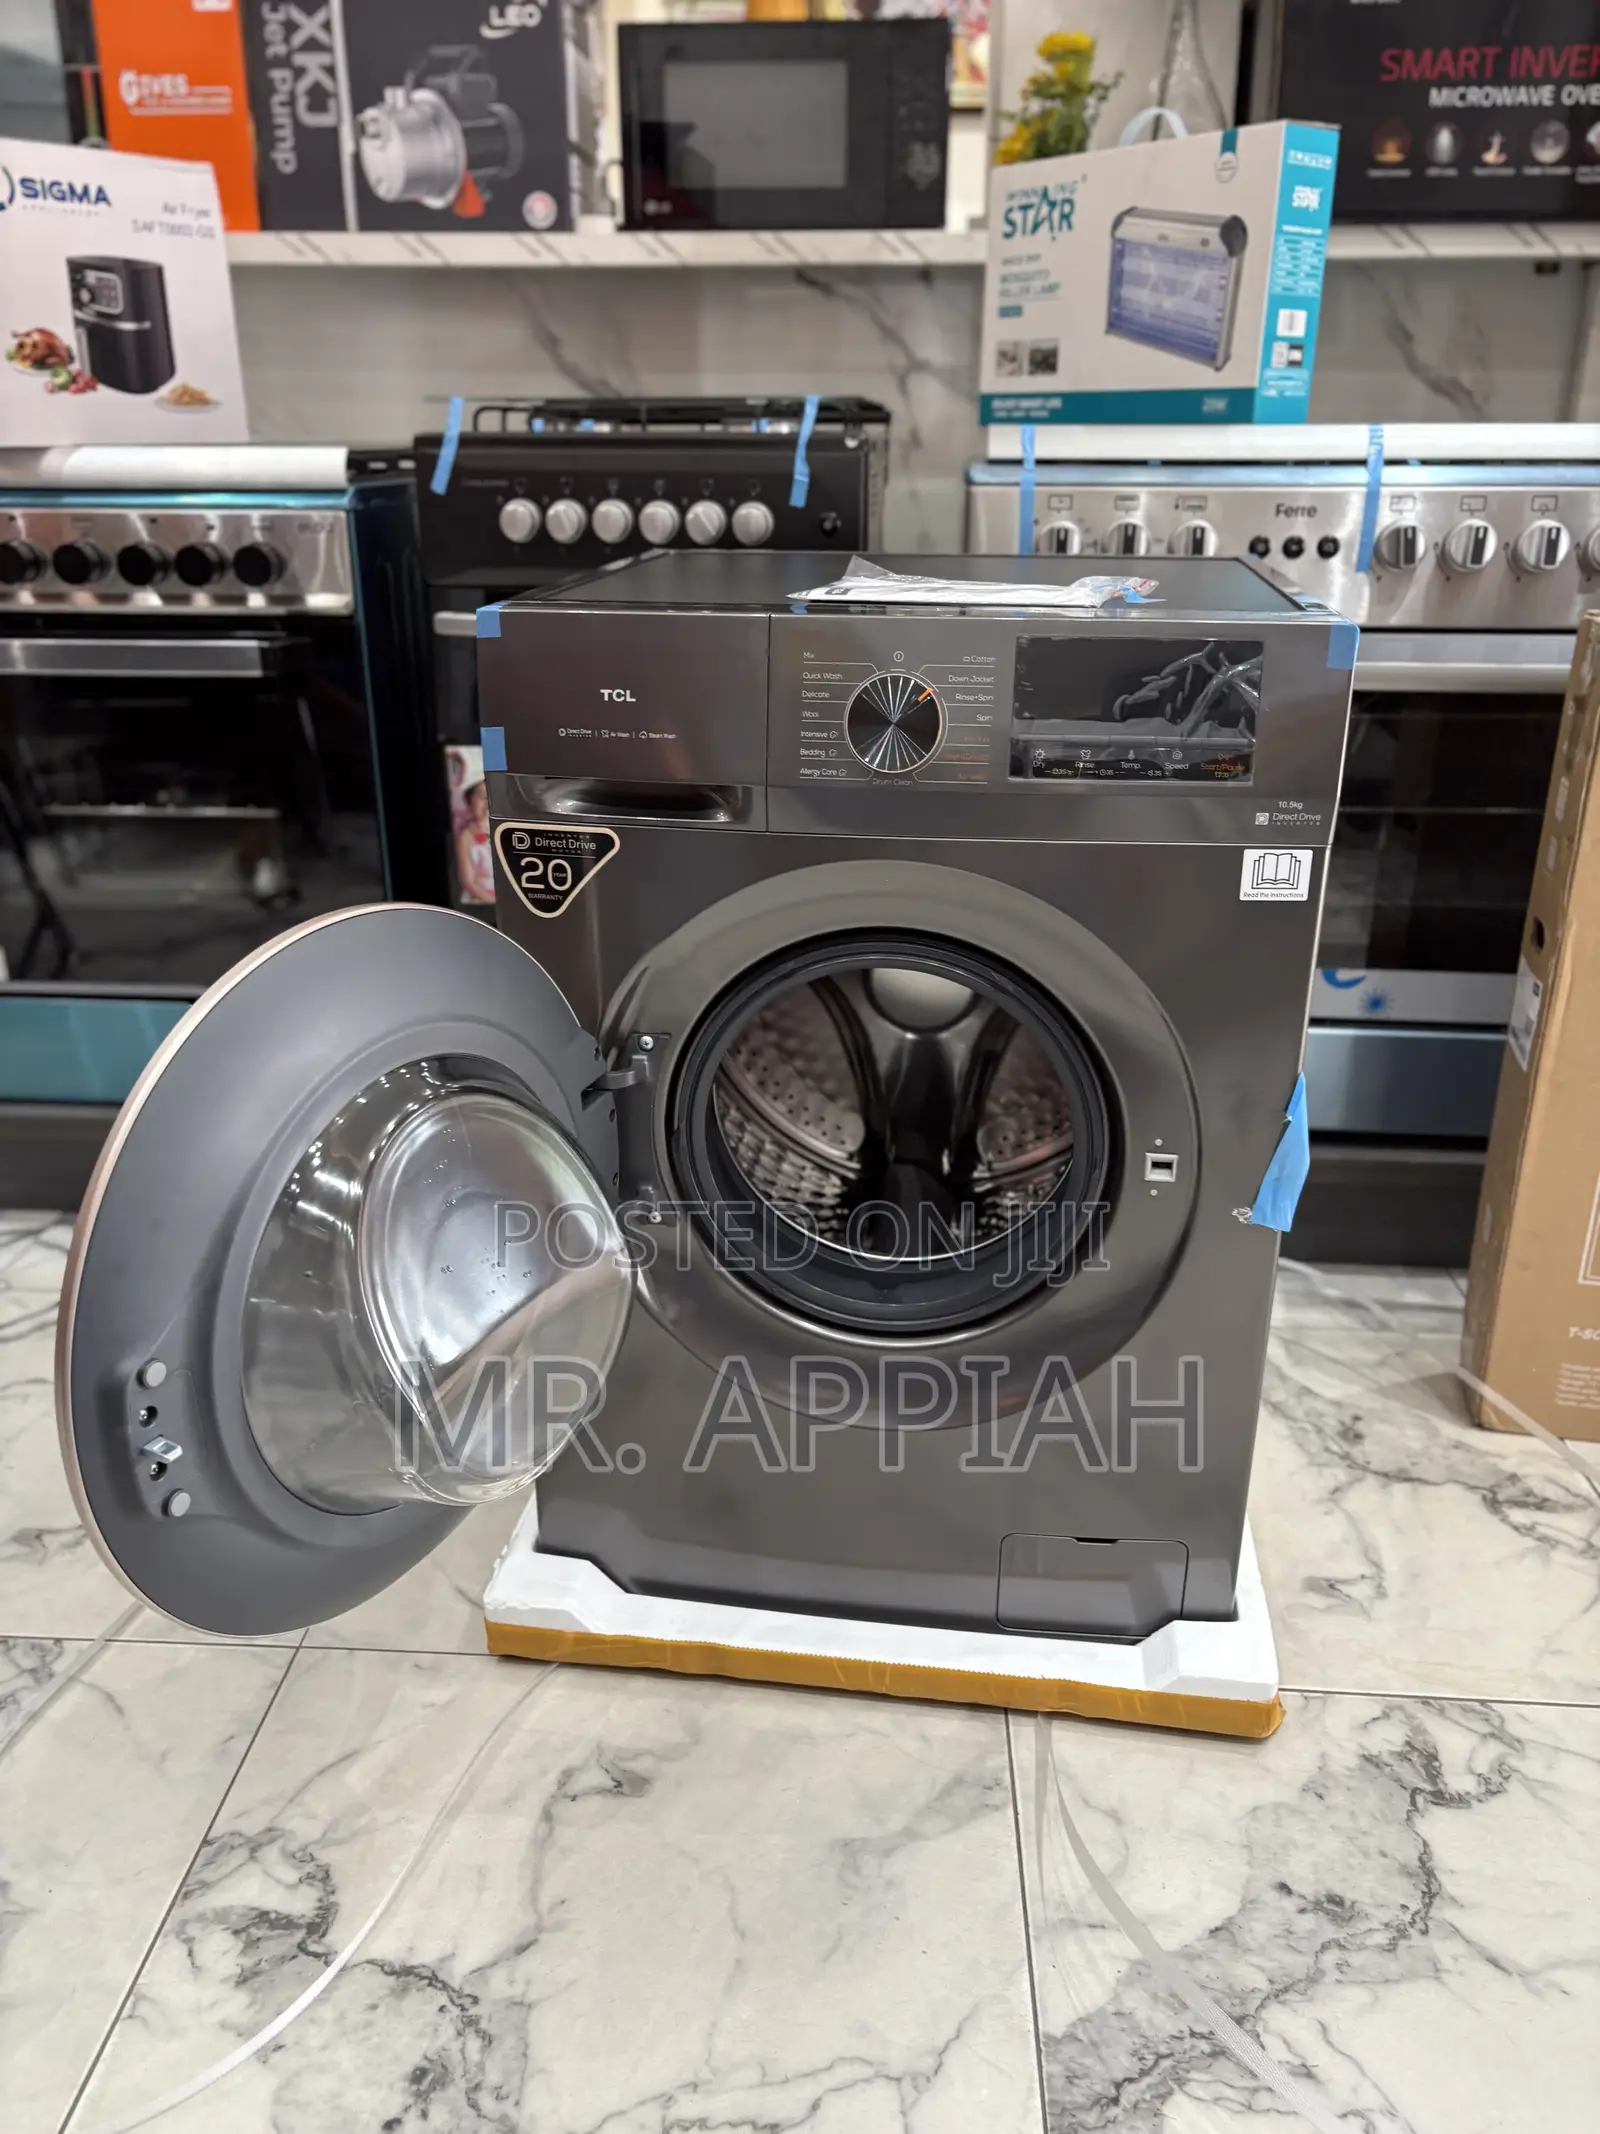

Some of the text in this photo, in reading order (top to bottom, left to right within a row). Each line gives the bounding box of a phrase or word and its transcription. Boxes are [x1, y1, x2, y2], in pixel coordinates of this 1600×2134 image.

[1378, 46, 1503, 82] SMART
[1428, 84, 1556, 108] MICROWAVE
[19, 177, 112, 207] SIGMA
[1002, 186, 1075, 239] STAR
[1274, 503, 1318, 518] Ferre
[970, 675, 995, 683] Jacket
[600, 689, 636, 702] TCL
[802, 690, 830, 698] Delicate
[976, 713, 993, 722] Spin
[800, 748, 826, 759] Bedding
[1164, 762, 1189, 770] Speed
[800, 768, 820, 778] Allergy
[1278, 801, 1303, 809] 10.5kg
[1272, 812, 1321, 821] Direct Drive
[535, 837, 596, 850] Direct Drive
[520, 857, 573, 892] 20
[527, 892, 563, 901] WARRANTY
[1271, 891, 1304, 899] instructions
